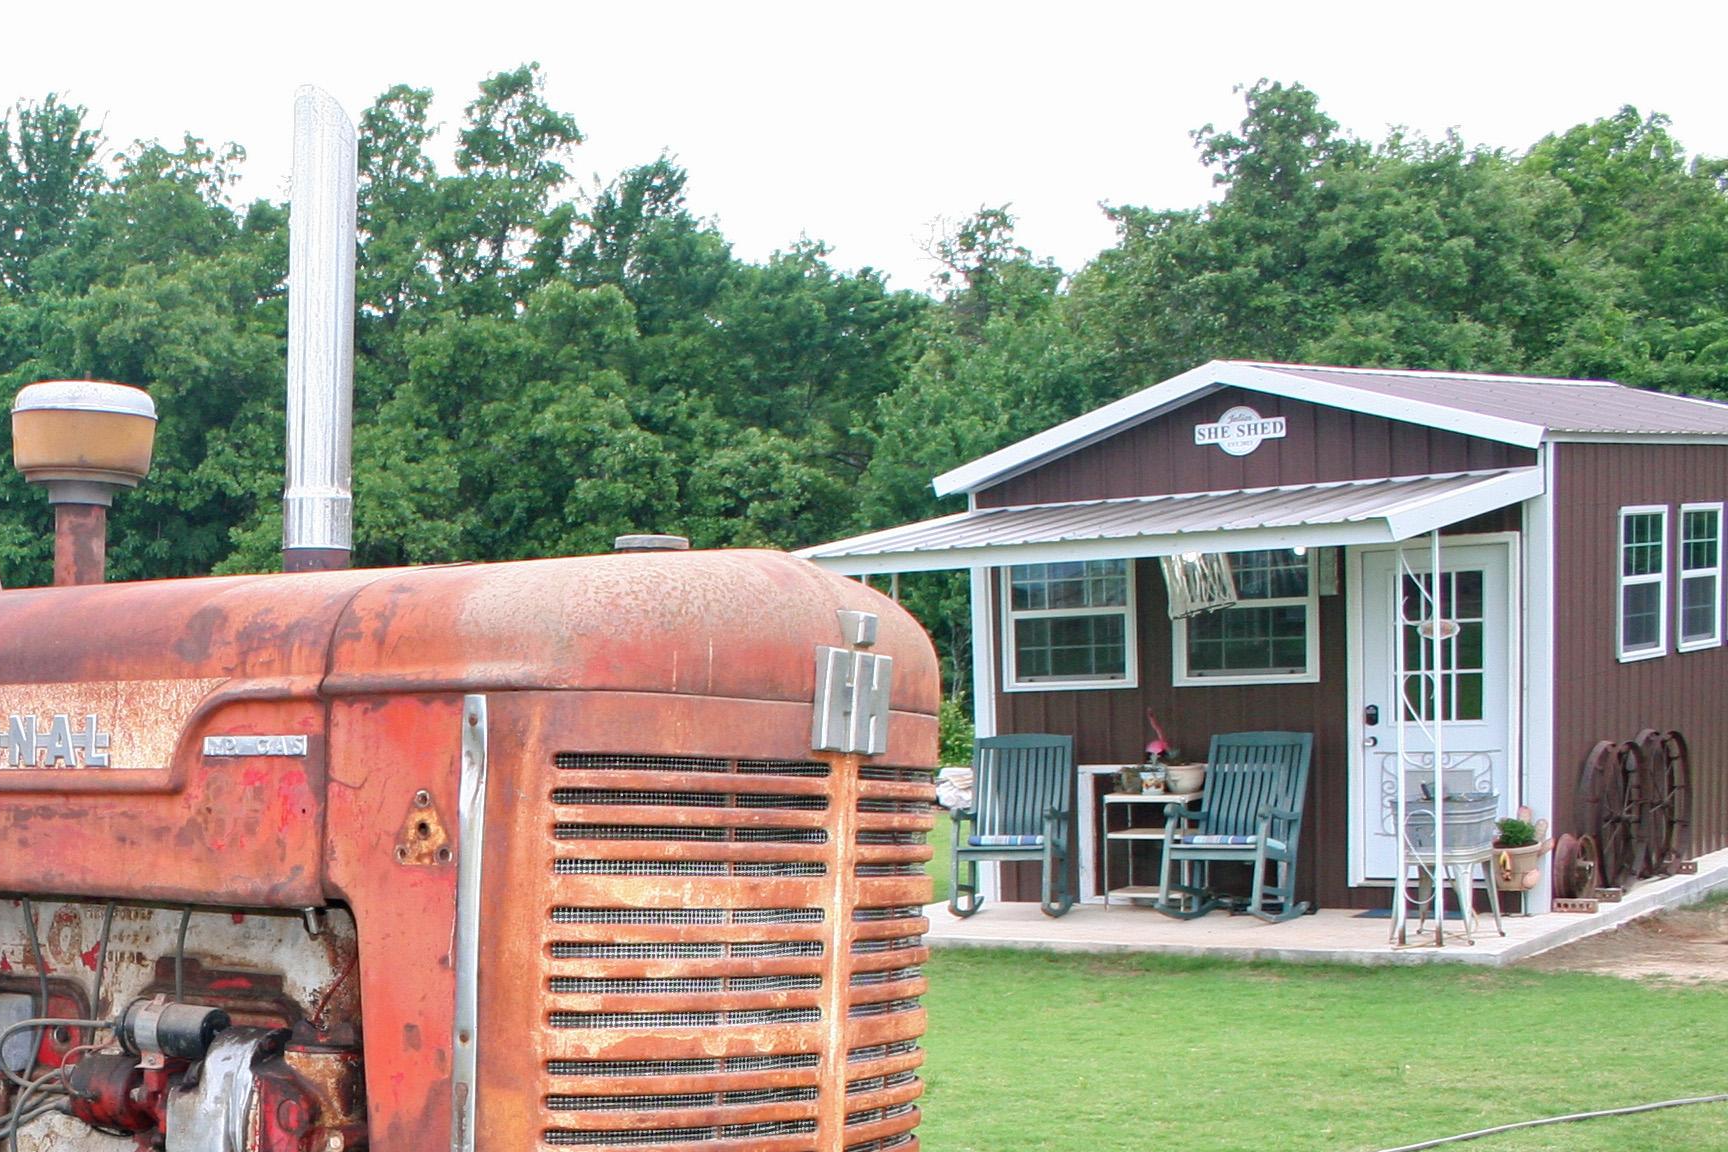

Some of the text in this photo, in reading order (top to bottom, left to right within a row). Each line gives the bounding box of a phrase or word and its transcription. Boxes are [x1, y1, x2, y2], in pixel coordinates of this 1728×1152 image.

[1197, 420, 1284, 441] SHE SHED
[256, 735, 305, 756] GAS
